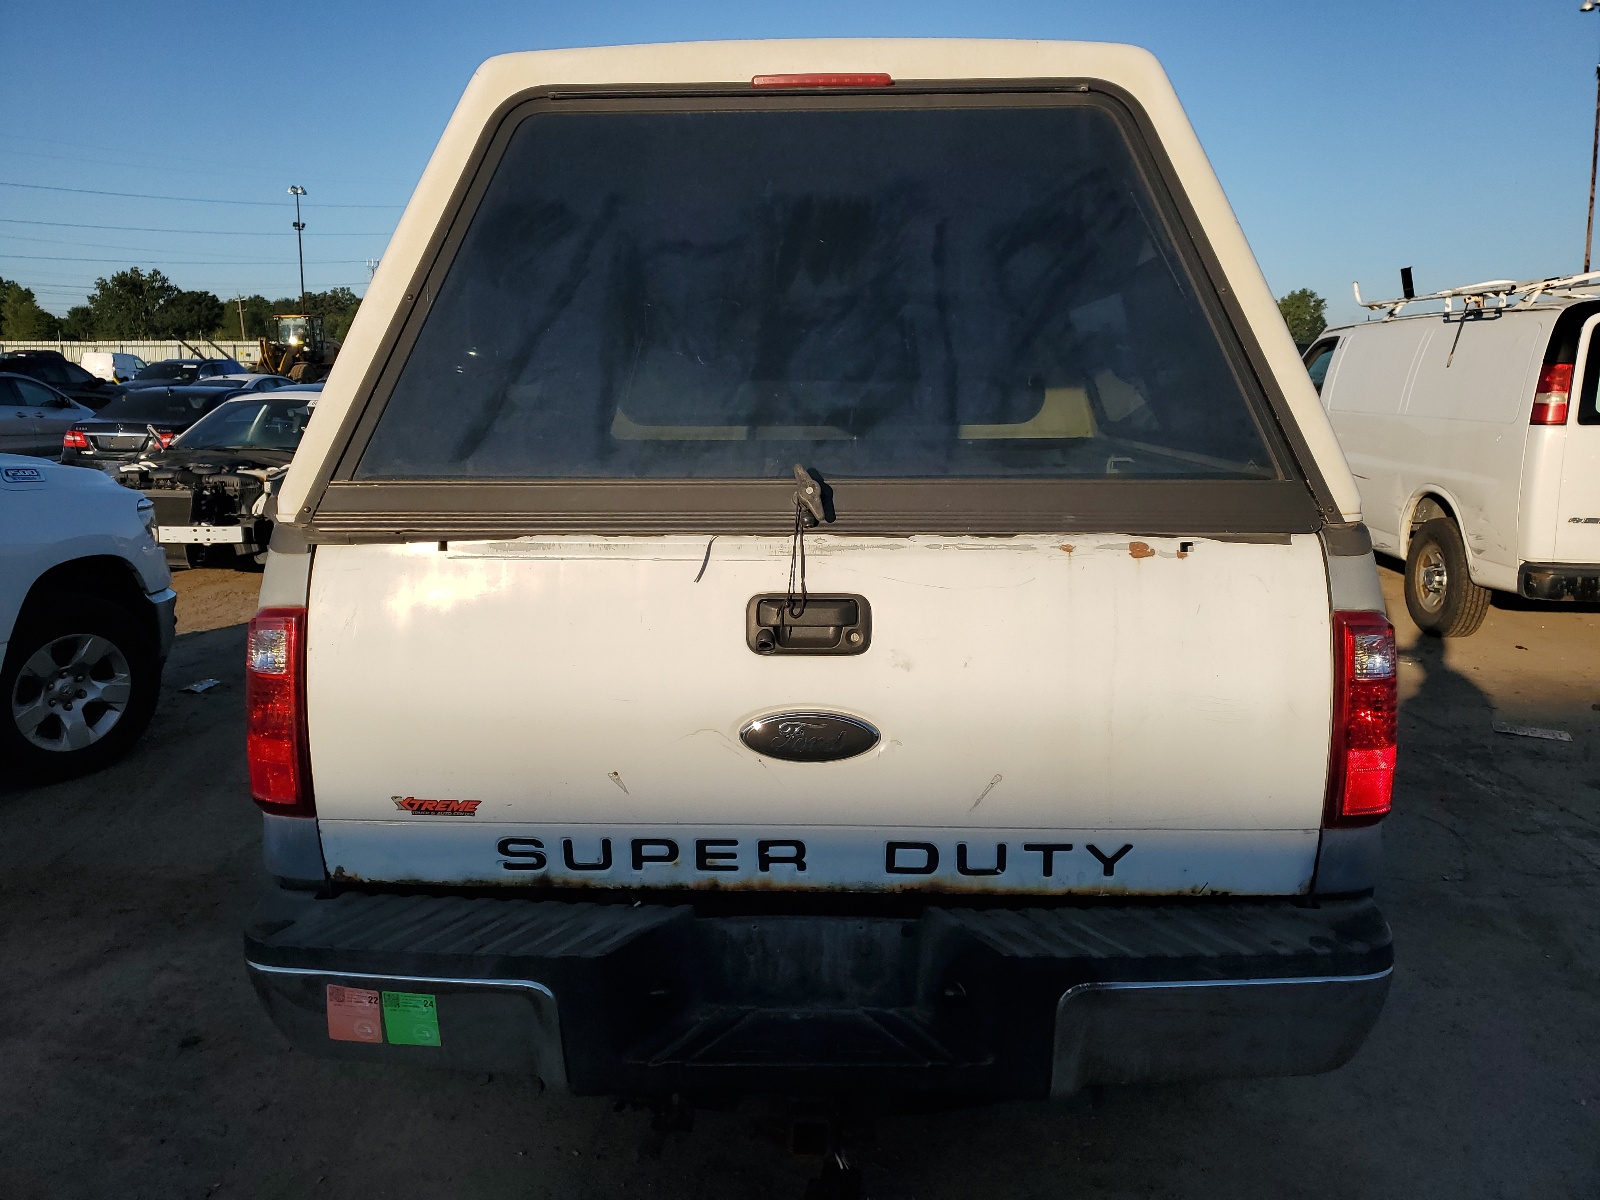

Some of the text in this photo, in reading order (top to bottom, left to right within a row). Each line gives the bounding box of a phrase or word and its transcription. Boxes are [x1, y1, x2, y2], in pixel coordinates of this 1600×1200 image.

[391, 796, 482, 811] XTREME
[496, 837, 1134, 878] SUPER DUTY
[368, 996, 379, 1005] 22
[423, 1000, 434, 1008] 24
